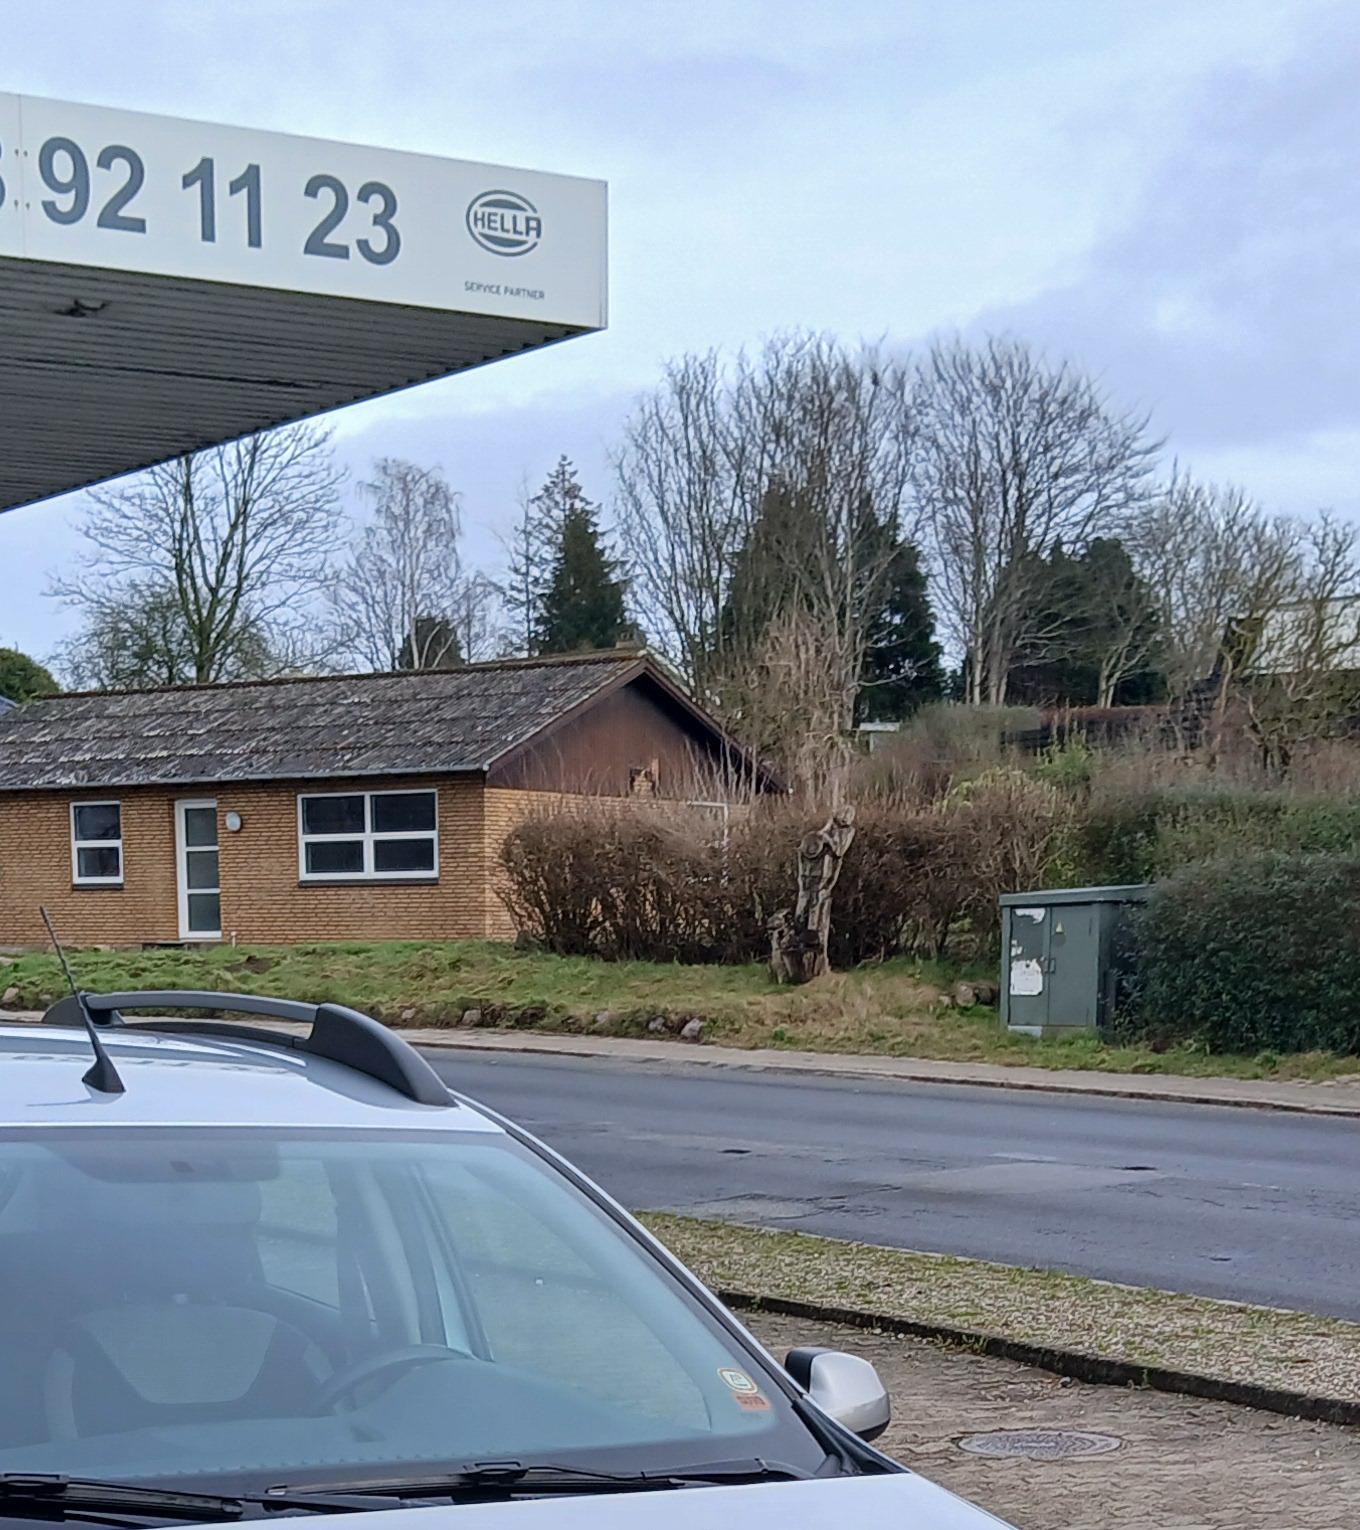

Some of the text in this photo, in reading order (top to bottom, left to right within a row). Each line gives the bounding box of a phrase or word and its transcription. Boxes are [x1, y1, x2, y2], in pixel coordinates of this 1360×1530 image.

[38, 136, 148, 236] 92
[181, 156, 263, 249] 11
[302, 173, 402, 266] 23
[473, 209, 542, 239] HELLA
[464, 280, 546, 300] SERVICE PARTNER
